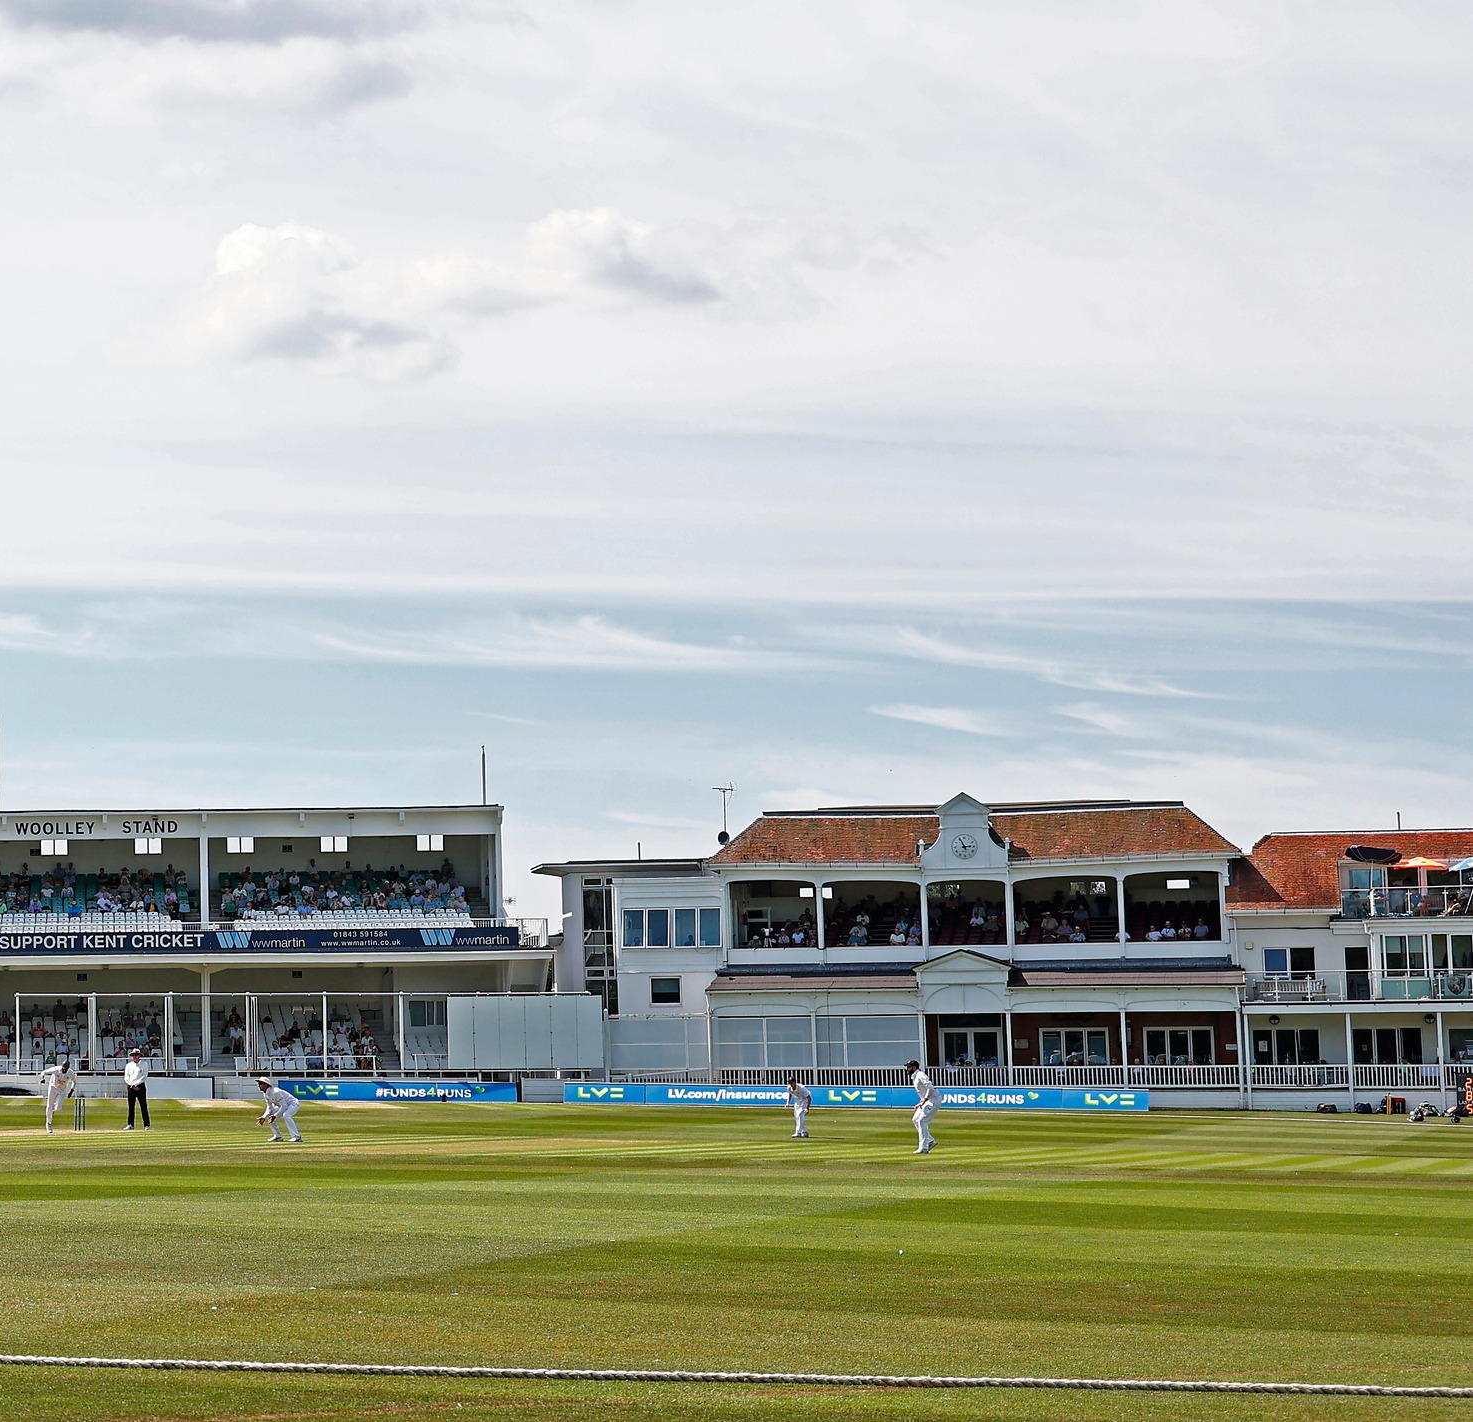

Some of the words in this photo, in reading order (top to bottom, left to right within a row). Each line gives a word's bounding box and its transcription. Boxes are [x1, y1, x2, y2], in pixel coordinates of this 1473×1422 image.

[15, 821, 96, 835] WOOLLEY
[122, 820, 179, 834] STAND
[0, 935, 77, 950] SUPPORT
[82, 934, 128, 949] KENT
[130, 933, 205, 948] CRICKET
[252, 936, 306, 948] wwmartin
[320, 938, 401, 947] www.wwmartin.co.uk
[455, 933, 510, 945] wwmartin
[292, 1084, 340, 1096] LV=
[375, 1087, 472, 1098] #FUNDS4RUNS
[577, 1086, 624, 1099] LV=
[667, 1088, 790, 1101] LV.com/insurance
[828, 1089, 877, 1102] LV=
[941, 1092, 1025, 1104] UNDS4RUNS
[1084, 1093, 1136, 1106] LV=
